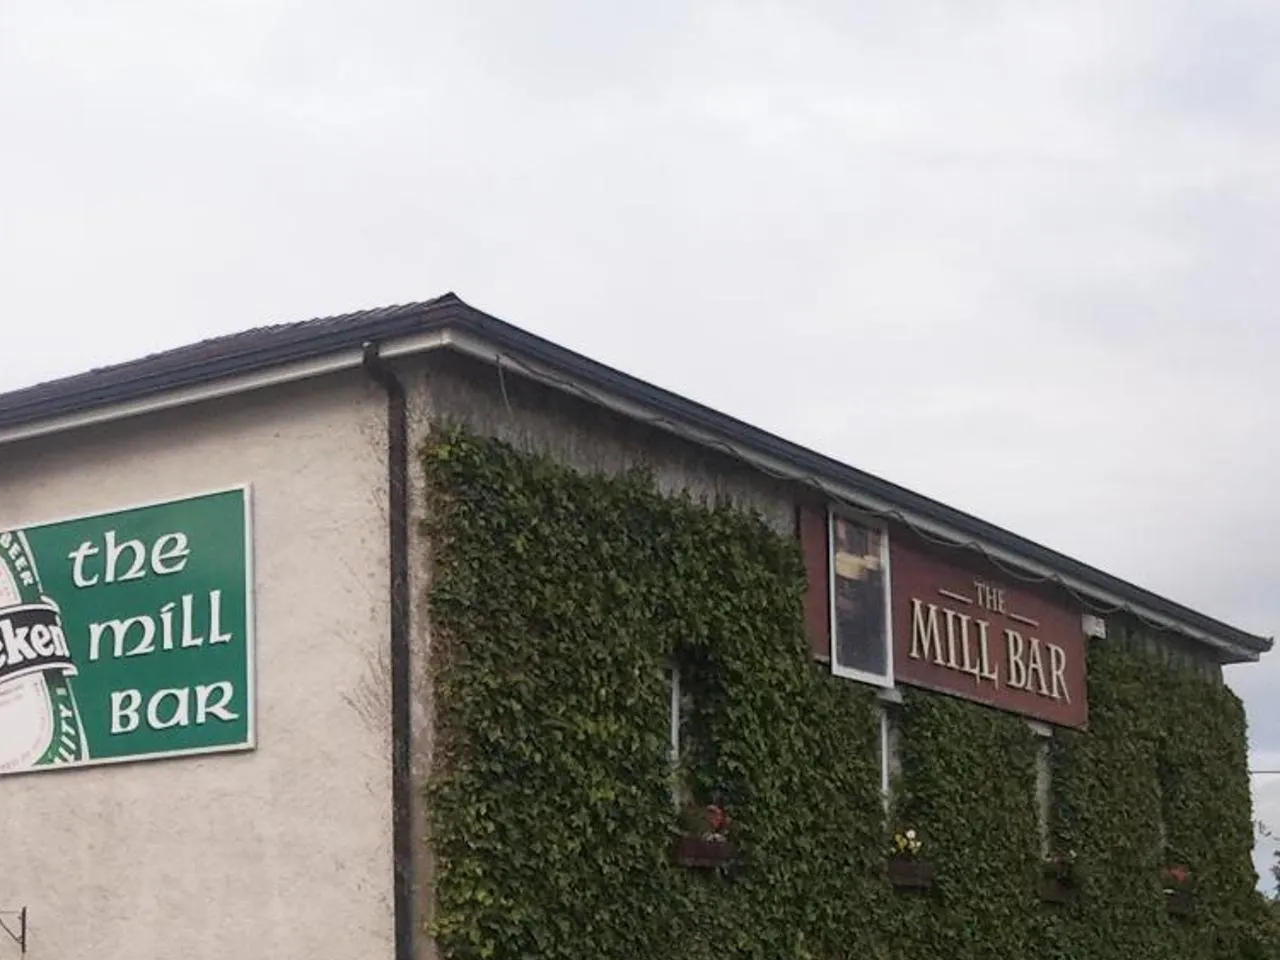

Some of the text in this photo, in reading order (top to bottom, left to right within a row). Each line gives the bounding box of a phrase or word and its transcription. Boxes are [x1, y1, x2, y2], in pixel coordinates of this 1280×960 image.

[68, 530, 191, 588] the
[973, 579, 1007, 614] THE
[907, 597, 1071, 704] MILL BAR
